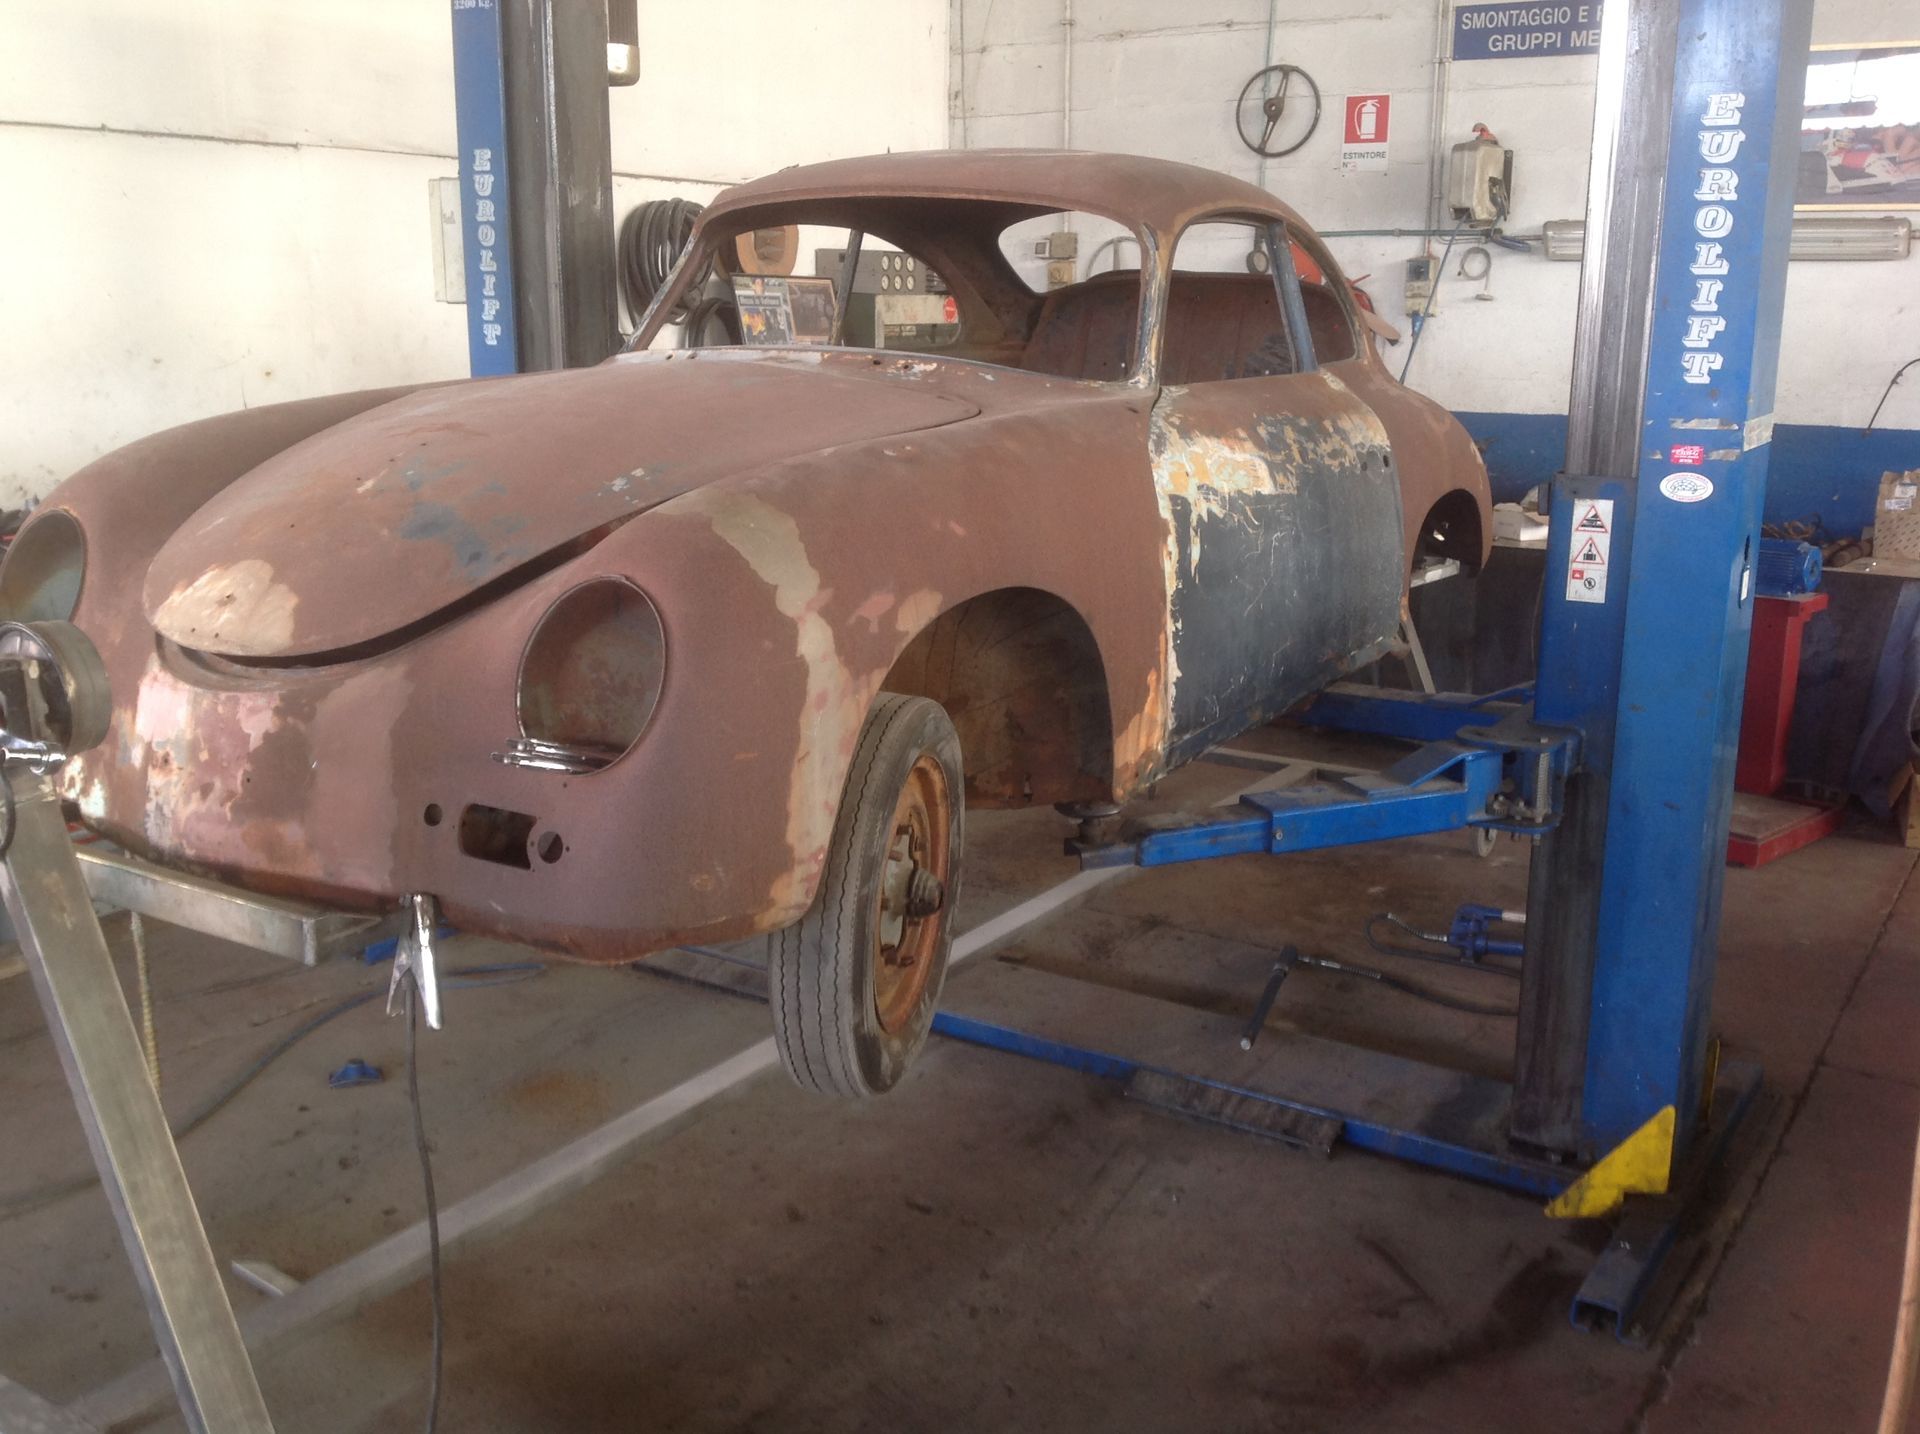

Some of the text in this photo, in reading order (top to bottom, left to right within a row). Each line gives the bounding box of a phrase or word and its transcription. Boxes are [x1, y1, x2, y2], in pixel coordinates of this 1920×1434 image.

[1461, 6, 1571, 30] SMONTAGGIO
[1578, 5, 1589, 23] E
[1488, 32, 1561, 52] GRUPPI
[1343, 151, 1387, 160] ESTINTORE
[472, 148, 501, 346] EUROLIFT
[1681, 91, 1746, 385] EUROLIFT
